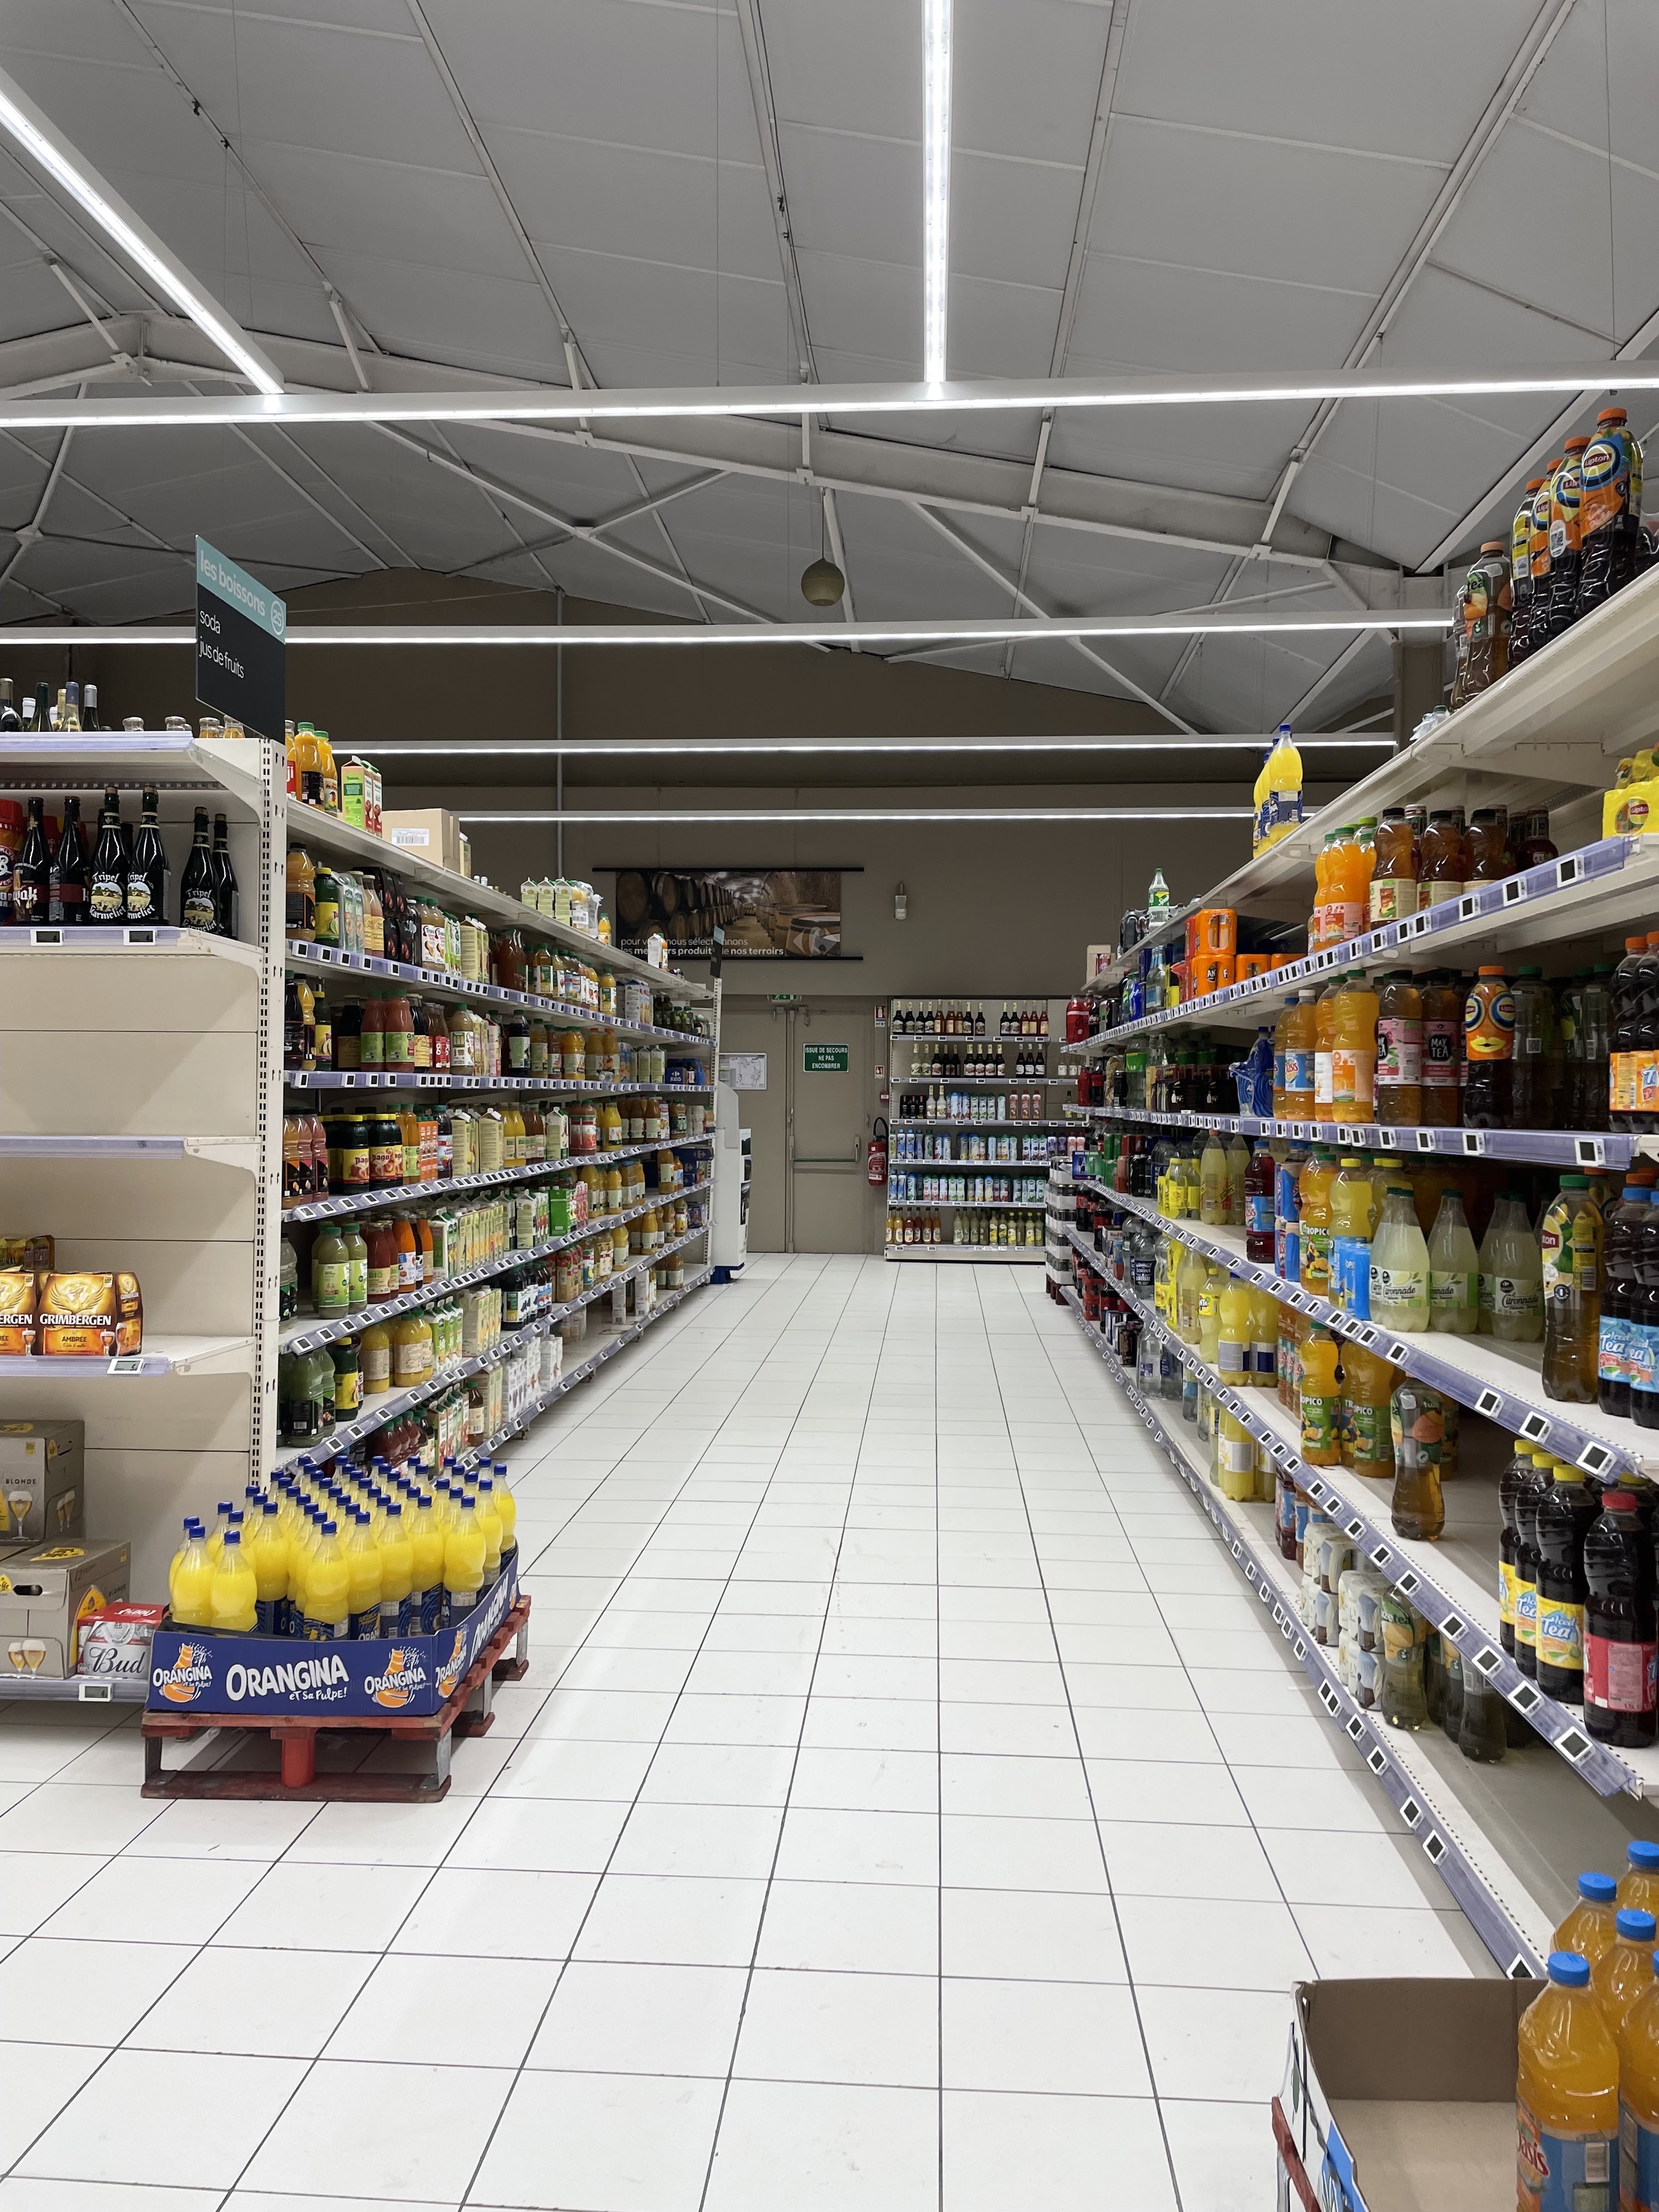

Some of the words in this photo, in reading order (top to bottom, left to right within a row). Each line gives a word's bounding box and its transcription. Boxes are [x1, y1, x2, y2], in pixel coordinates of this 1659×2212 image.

[1584, 455, 1611, 468] Lipton
[200, 549, 217, 581] les
[219, 562, 266, 617] boissons
[200, 610, 221, 635] soda
[273, 608, 282, 628] 25
[199, 635, 212, 659] jus
[212, 646, 224, 666] de
[224, 651, 245, 679] fruits
[92, 871, 121, 883] Tripel
[185, 887, 212, 899] Tripel
[621, 939, 641, 949] pour
[678, 947, 712, 957] produit
[1431, 1046, 1449, 1058] TEA
[40, 1313, 111, 1326] GRIMBERGEN
[1541, 1617, 1571, 1639] Tea
[89, 1646, 146, 1674] Bud
[153, 1665, 213, 1687] ORANGINA
[225, 1654, 351, 1701] ORANGINA
[364, 1667, 427, 1695] ORANGINA
